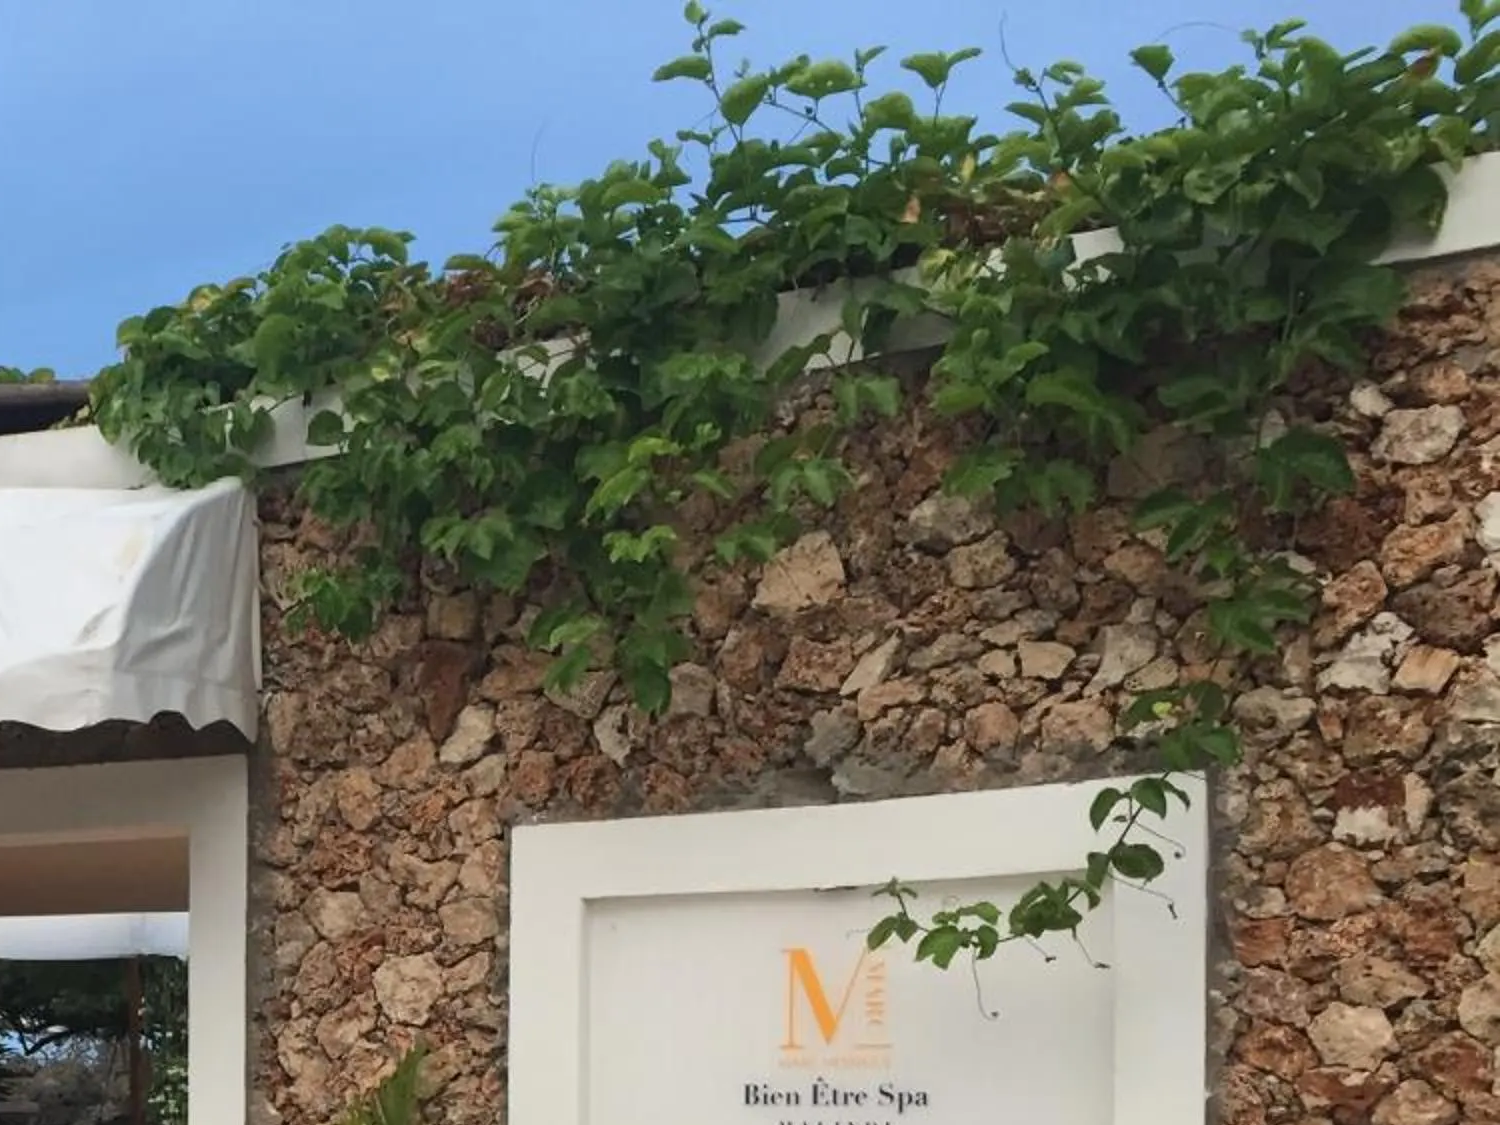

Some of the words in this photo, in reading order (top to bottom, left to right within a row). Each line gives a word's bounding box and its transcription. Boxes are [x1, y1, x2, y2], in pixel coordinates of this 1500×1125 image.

[744, 1083, 801, 1106] Bien
[812, 1076, 869, 1106] Être
[877, 1082, 929, 1115] Spa
